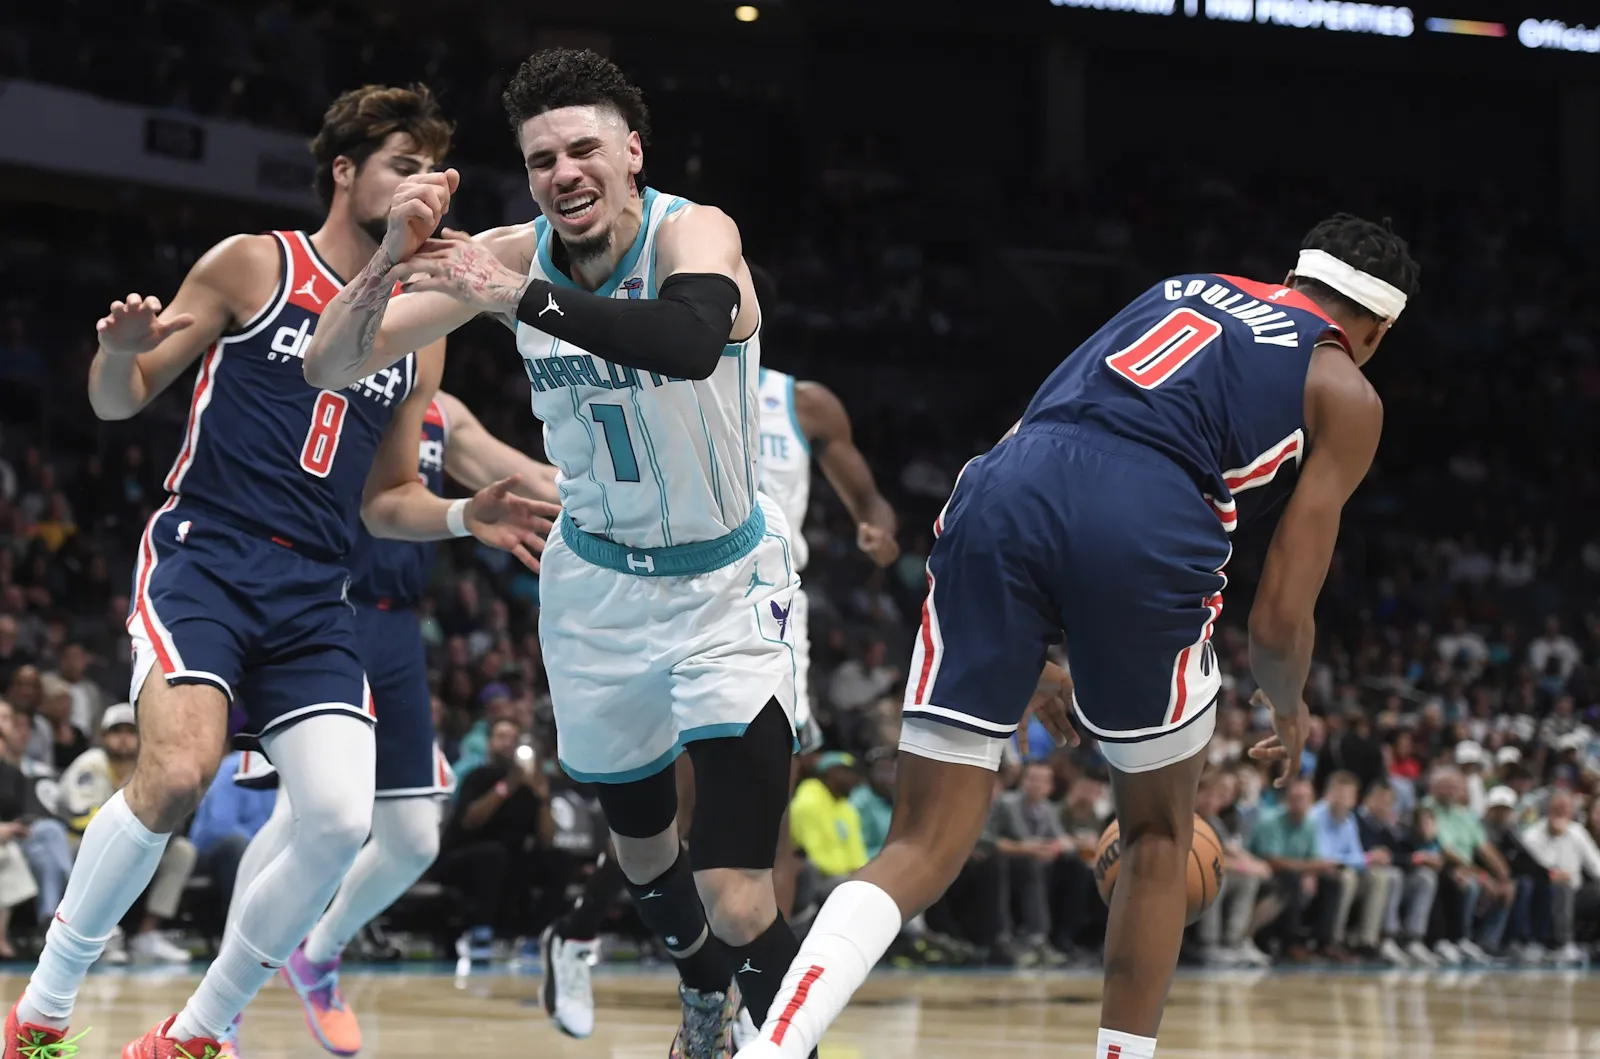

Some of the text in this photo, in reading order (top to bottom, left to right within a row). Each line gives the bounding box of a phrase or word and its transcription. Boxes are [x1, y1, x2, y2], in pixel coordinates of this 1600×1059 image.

[1256, 0, 1414, 37] PROPERTIES
[1105, 307, 1223, 390] 0
[1164, 279, 1299, 348] COULIBALY
[300, 389, 349, 478] 8
[589, 403, 641, 482] 1
